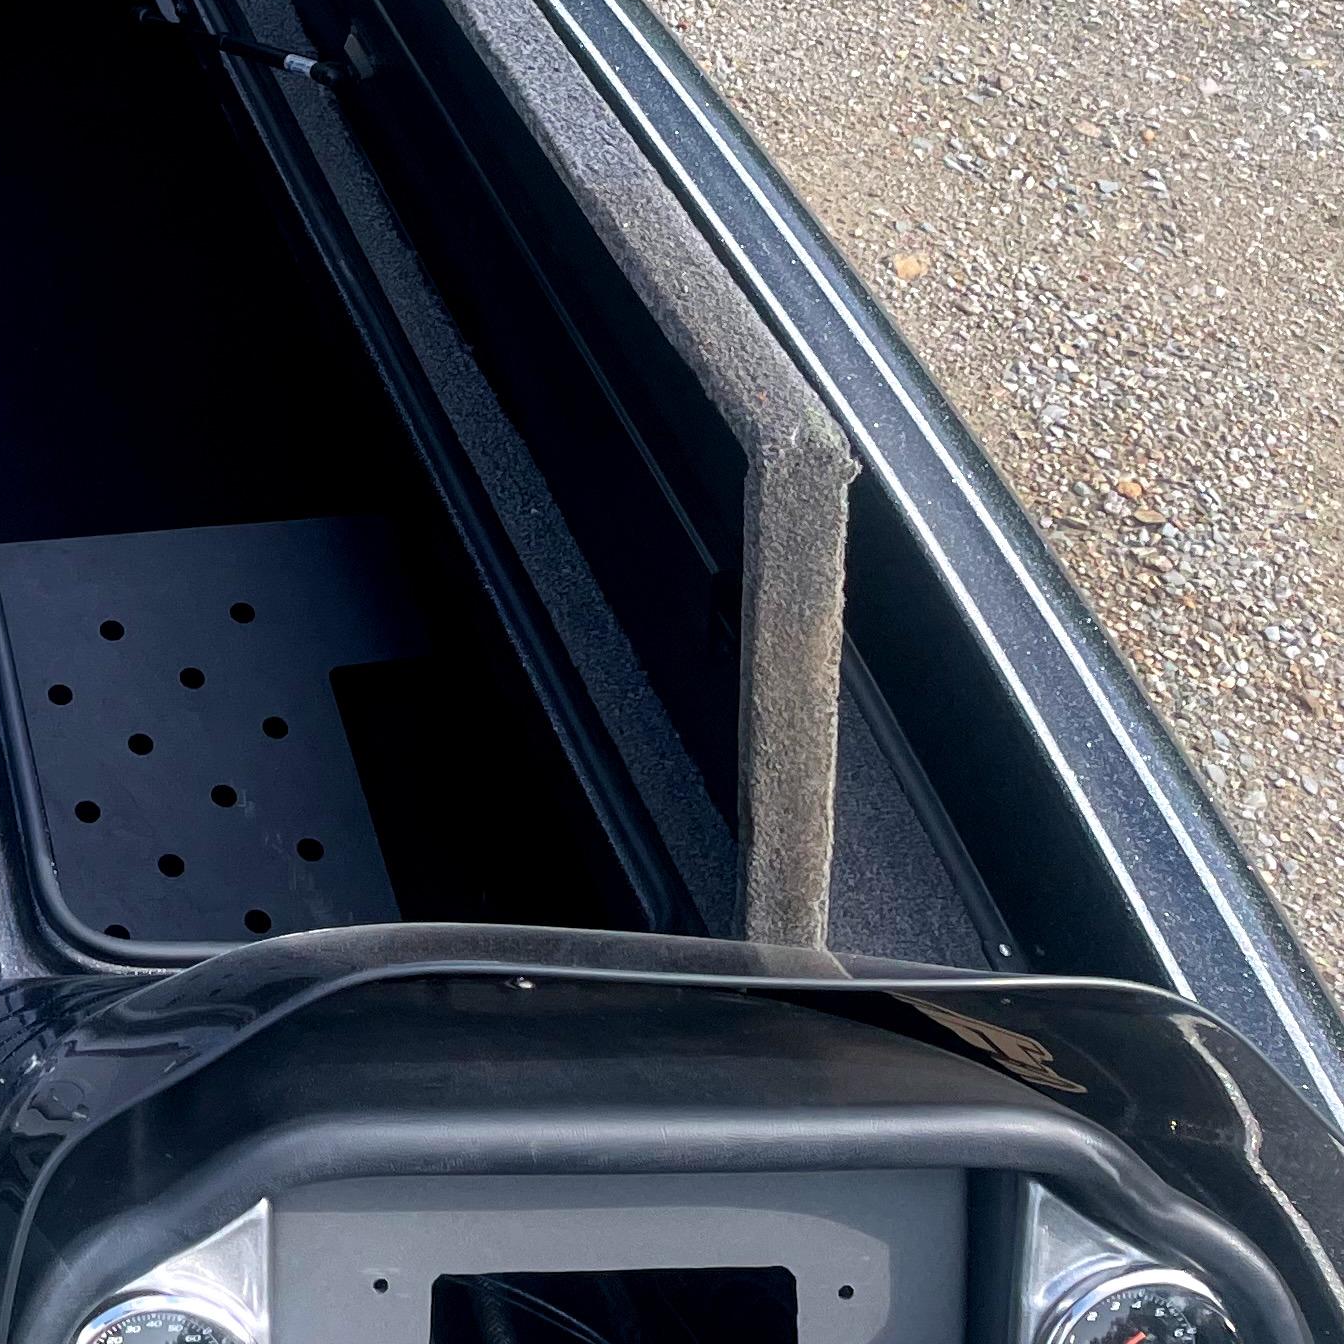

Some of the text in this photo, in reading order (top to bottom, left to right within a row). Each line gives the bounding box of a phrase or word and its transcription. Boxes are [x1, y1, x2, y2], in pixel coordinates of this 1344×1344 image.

[1110, 1301, 1121, 1311] 3
[1131, 1300, 1142, 1309] 4
[1086, 1311, 1098, 1322] 2
[1154, 1307, 1165, 1317] 5
[145, 1319, 163, 1328] 40
[125, 1325, 141, 1334] 30
[167, 1324, 184, 1333] 50
[184, 1334, 202, 1343] 60
